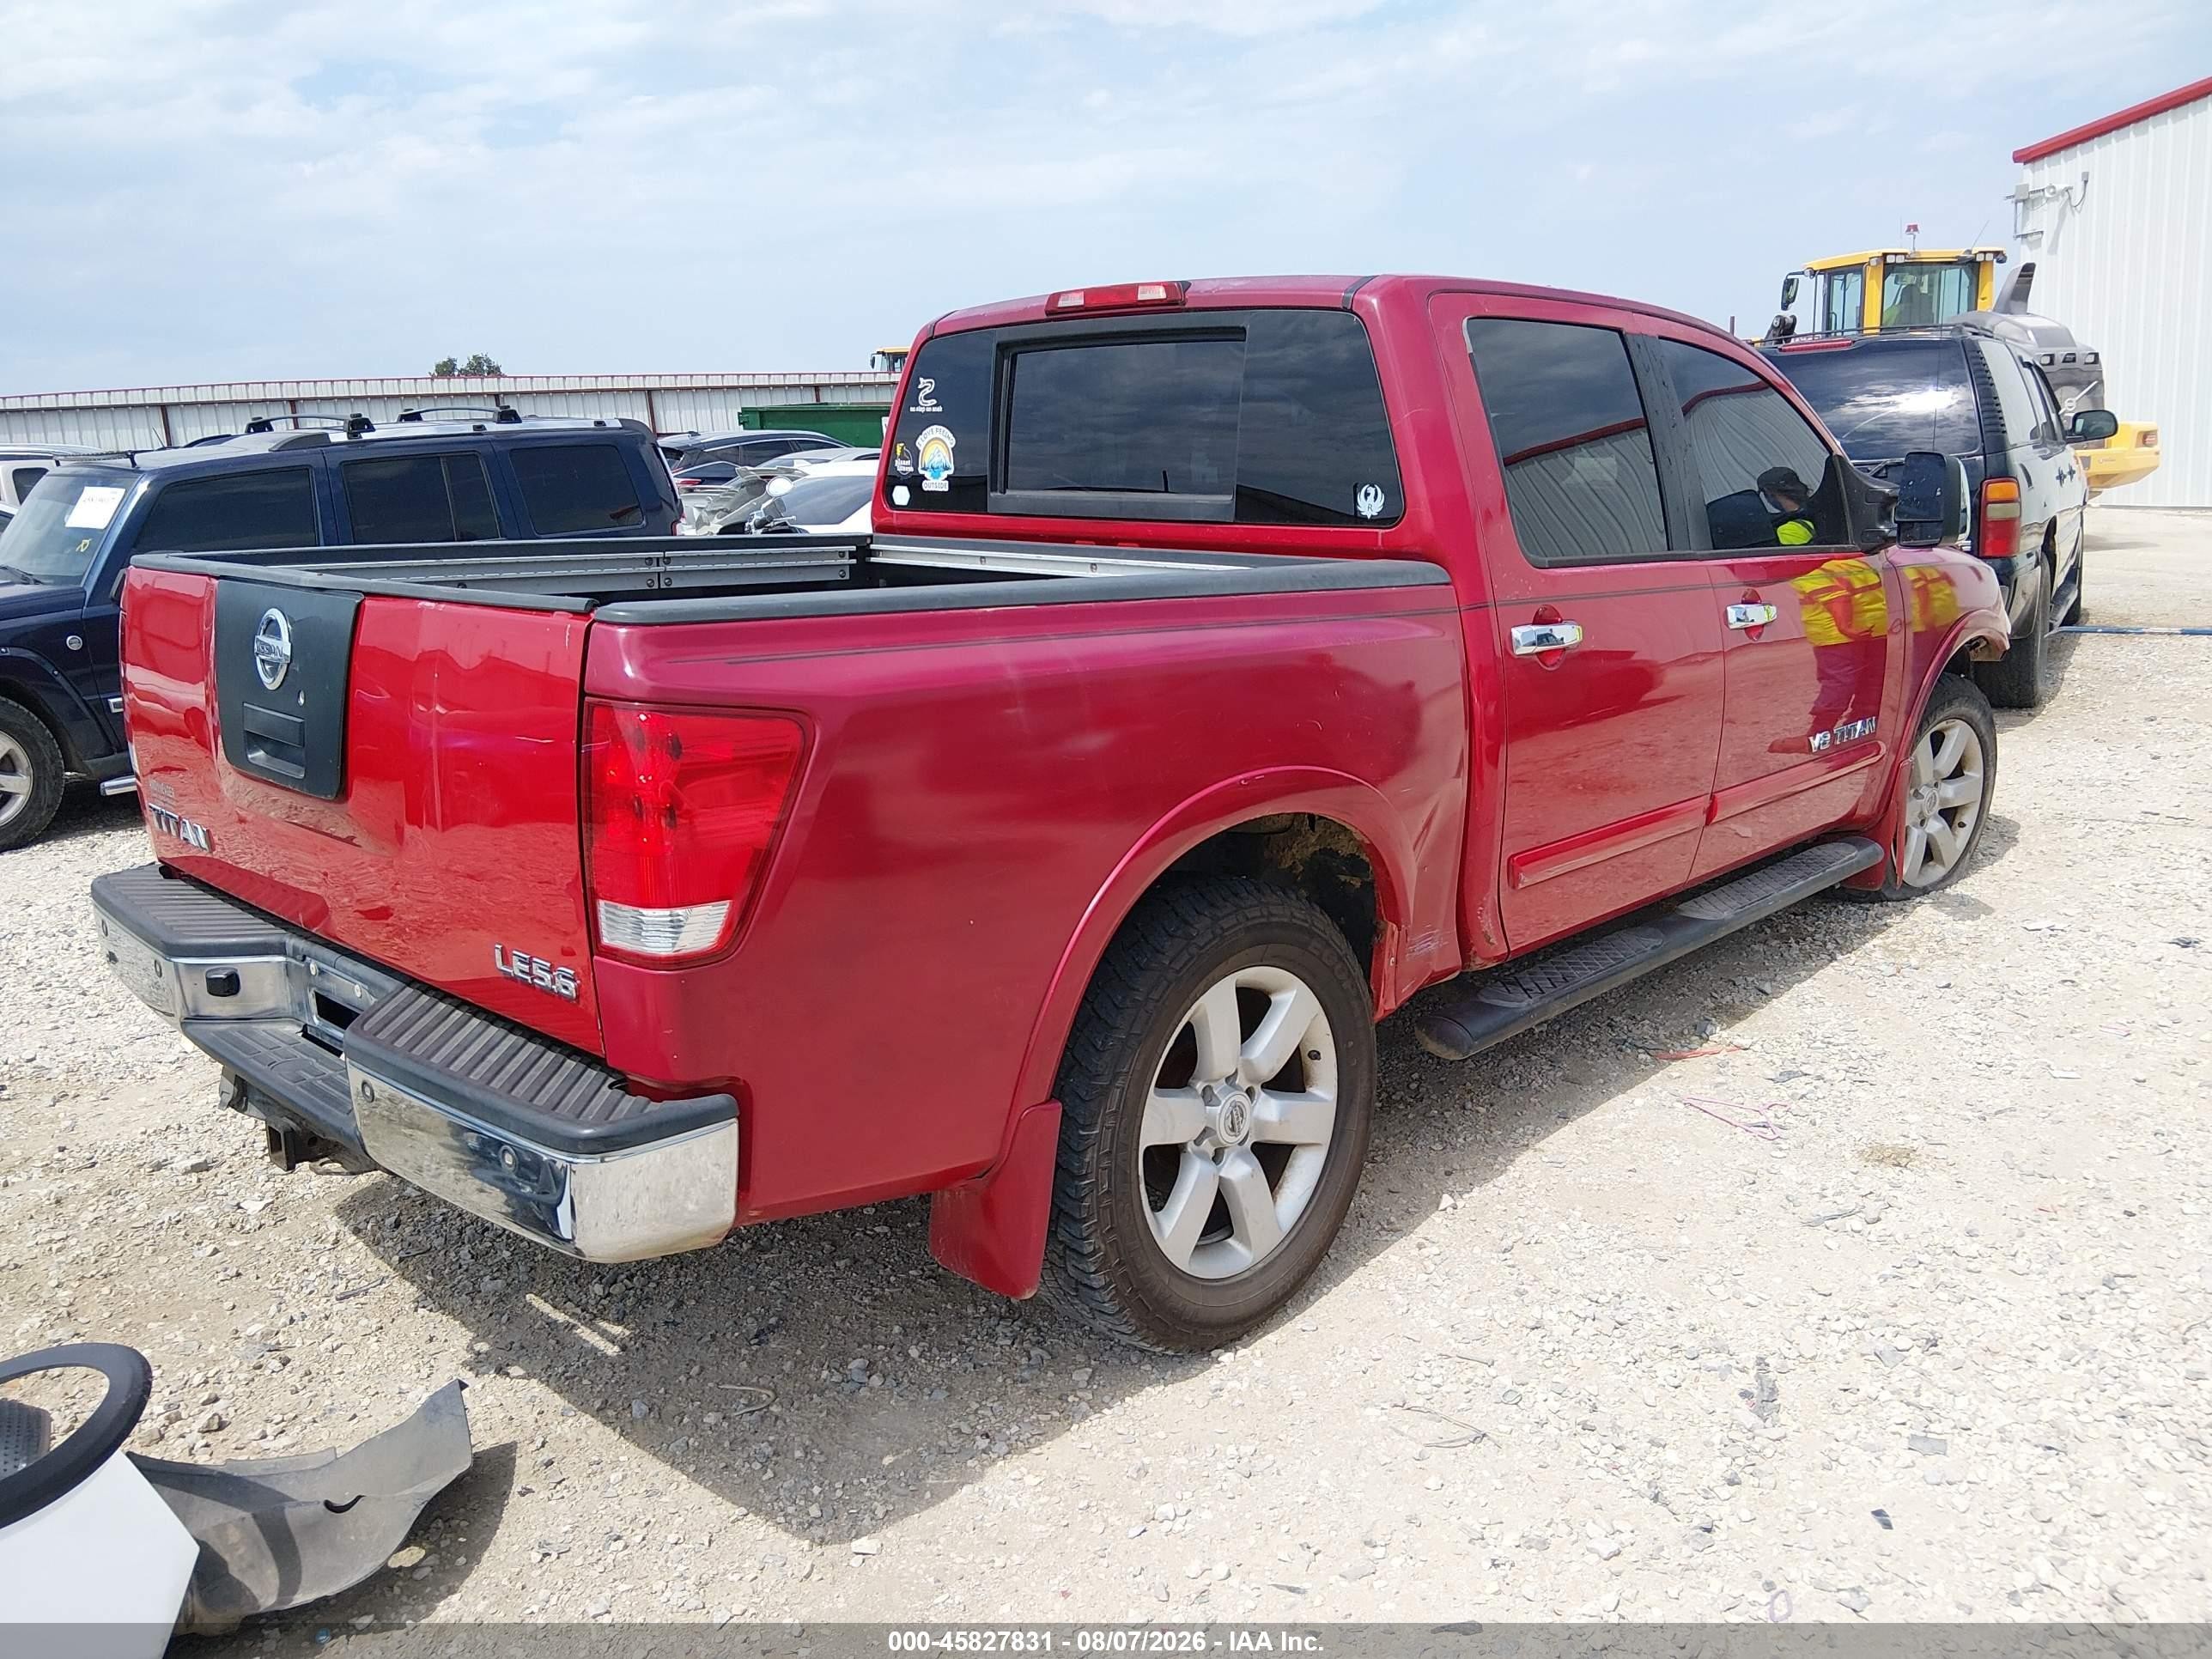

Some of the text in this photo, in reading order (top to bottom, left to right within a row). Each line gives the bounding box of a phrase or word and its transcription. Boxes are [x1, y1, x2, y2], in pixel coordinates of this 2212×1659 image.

[921, 428, 934, 443] LOVE
[935, 427, 954, 446] PEEING
[1833, 716, 1876, 745] TITAN
[148, 802, 212, 853] TITAN
